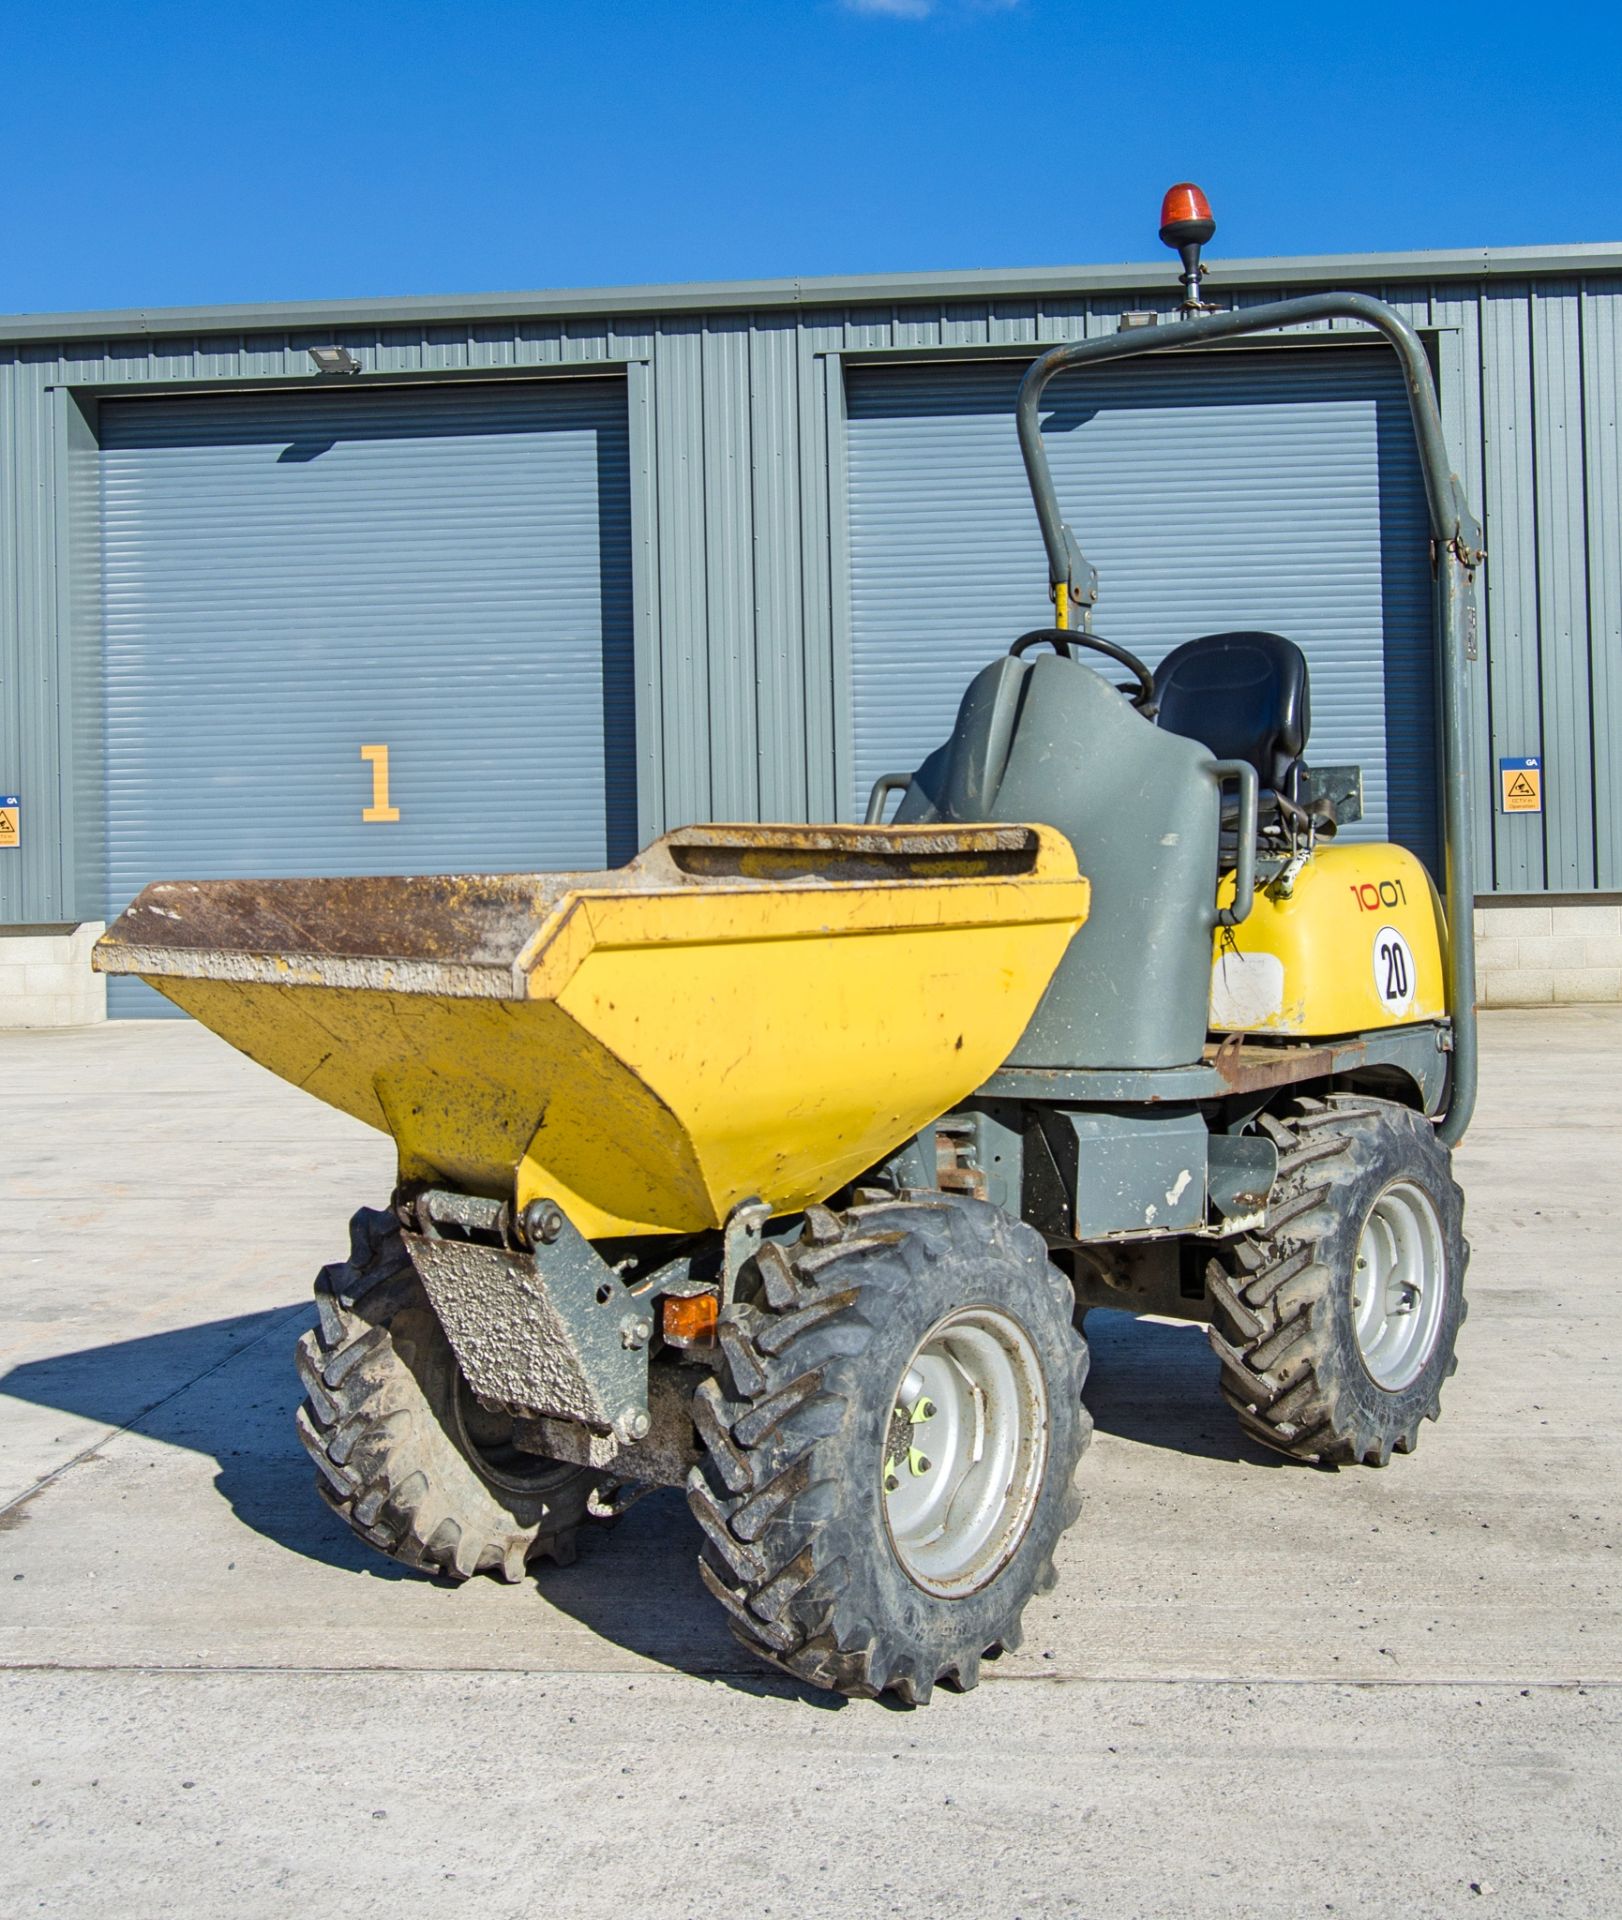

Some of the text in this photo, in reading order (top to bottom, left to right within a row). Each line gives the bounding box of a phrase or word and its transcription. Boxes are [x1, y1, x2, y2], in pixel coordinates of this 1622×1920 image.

[361, 745, 400, 822] 1
[1350, 879, 1407, 912] 1001
[1381, 942, 1408, 1000] 20
